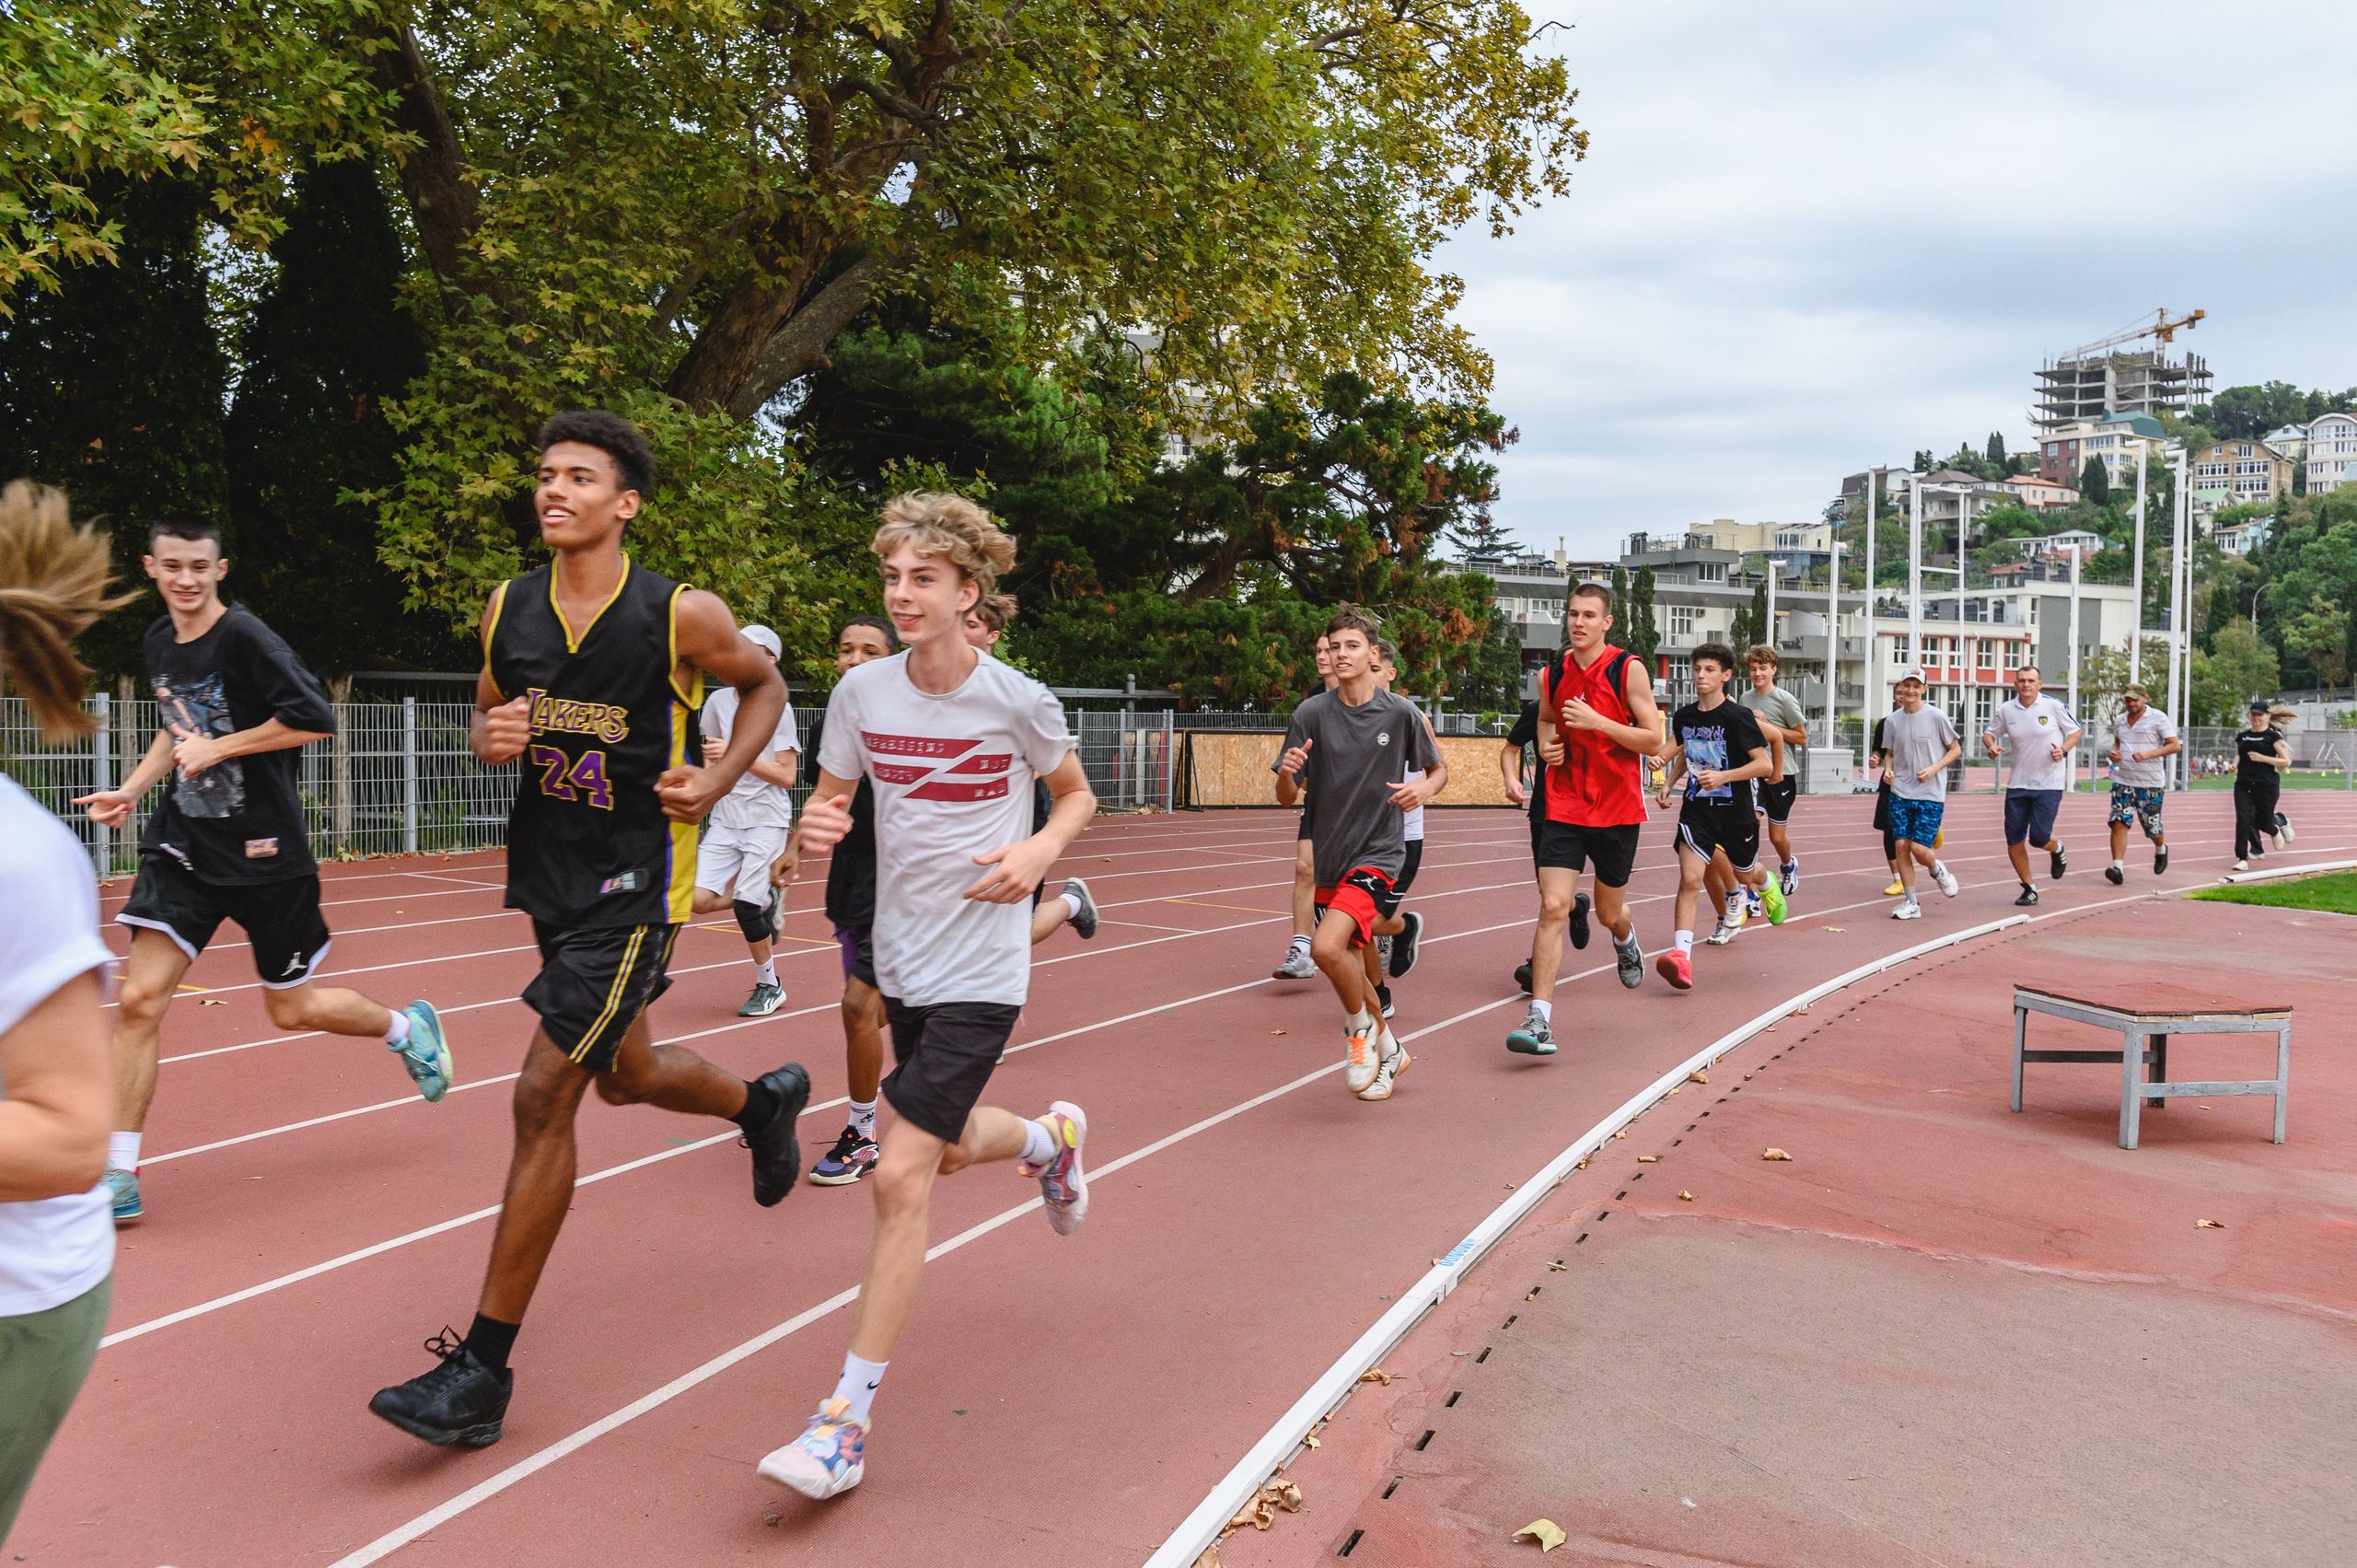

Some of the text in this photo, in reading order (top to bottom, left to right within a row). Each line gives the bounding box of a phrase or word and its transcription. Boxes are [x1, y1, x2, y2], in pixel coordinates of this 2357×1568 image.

[527, 688, 630, 743] LAKERS
[528, 744, 614, 812] 24
[1438, 1242, 1475, 1267] MONDO
